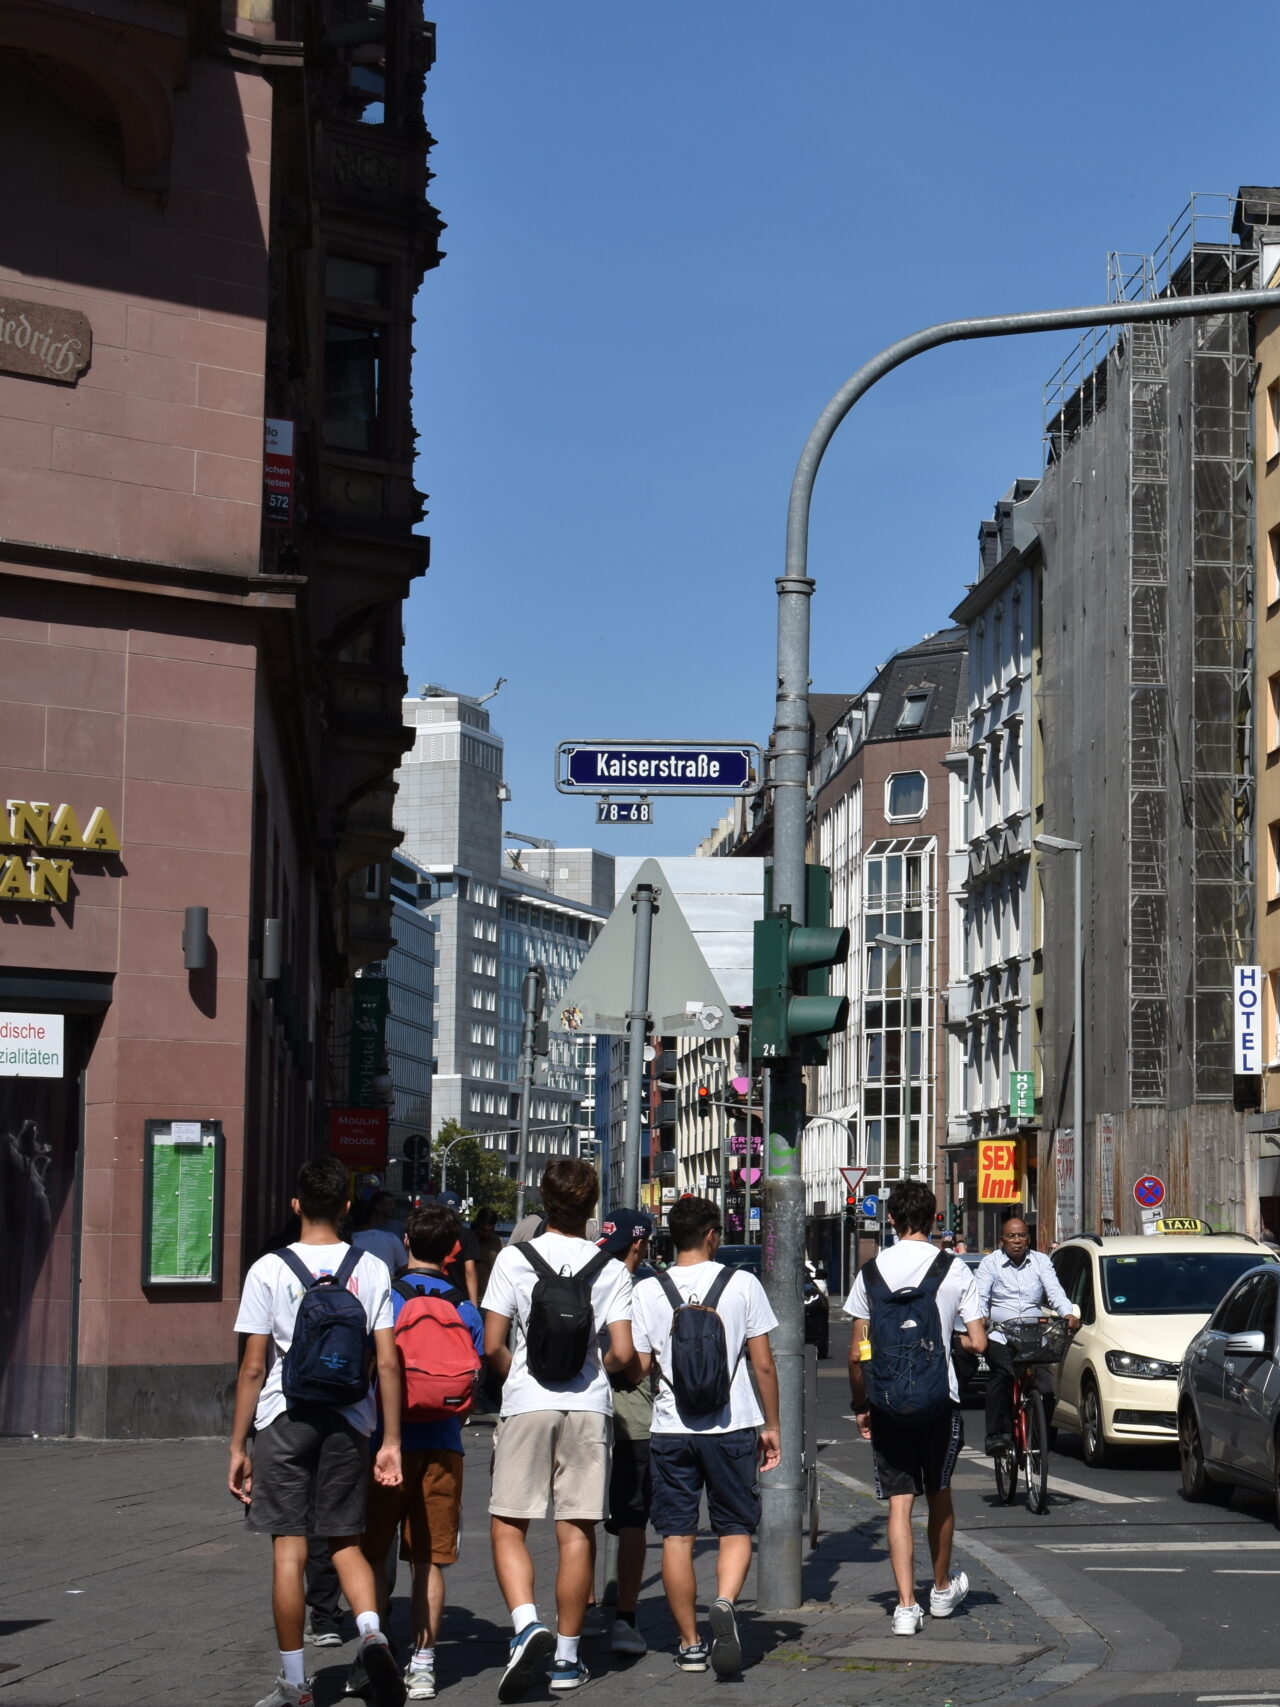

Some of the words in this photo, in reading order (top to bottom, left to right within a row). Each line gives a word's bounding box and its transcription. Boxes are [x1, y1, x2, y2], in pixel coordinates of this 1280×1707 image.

[597, 753, 720, 778] Kaiserstraße
[600, 803, 649, 821] 78-68
[1239, 968, 1258, 1072] HOTEL
[763, 1043, 776, 1057] 24
[1016, 1074, 1028, 1117] HOTEL
[982, 1145, 1018, 1171] SEX
[981, 1173, 1019, 1199] Inn
[1166, 1220, 1195, 1230] TAXI
